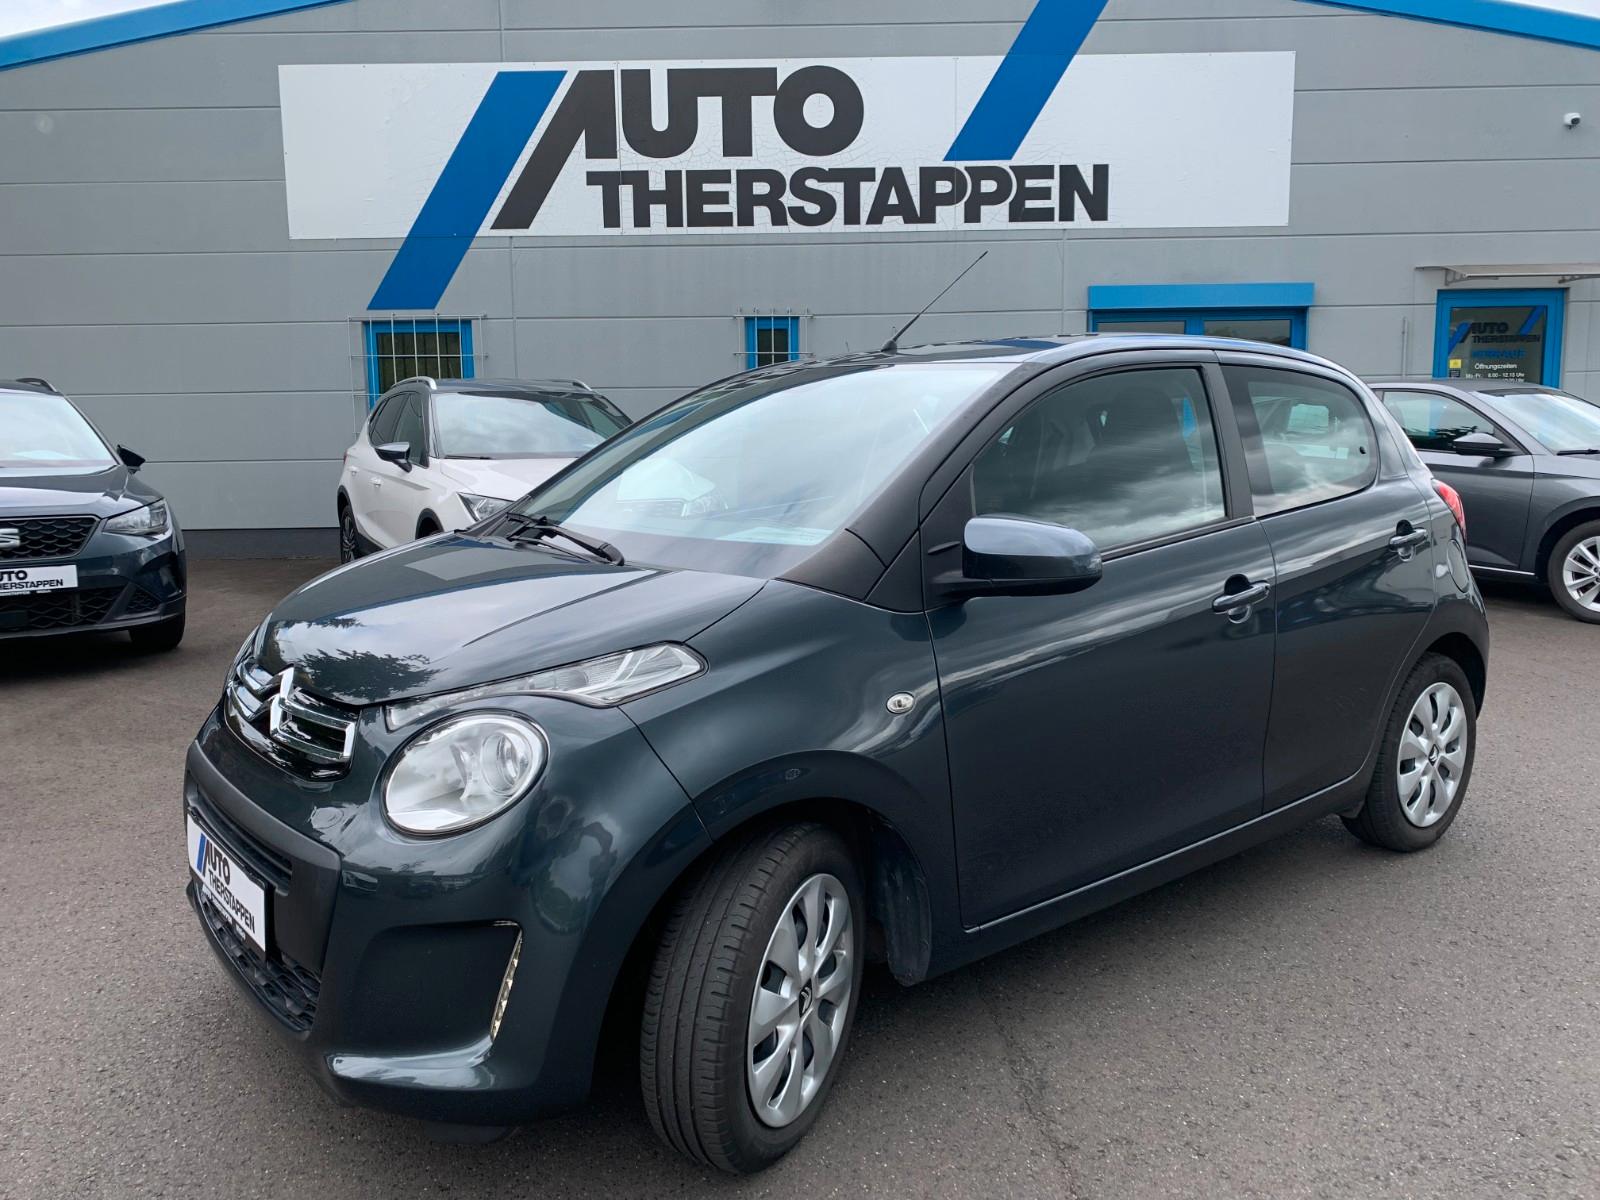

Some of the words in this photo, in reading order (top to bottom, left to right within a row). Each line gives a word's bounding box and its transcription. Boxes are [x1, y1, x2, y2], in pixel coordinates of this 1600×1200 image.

[490, 66, 864, 230] AUTO
[586, 164, 1109, 229] THERSTAPPEN
[203, 839, 231, 886] AUTO
[208, 868, 256, 934] THERSTAPPEN
